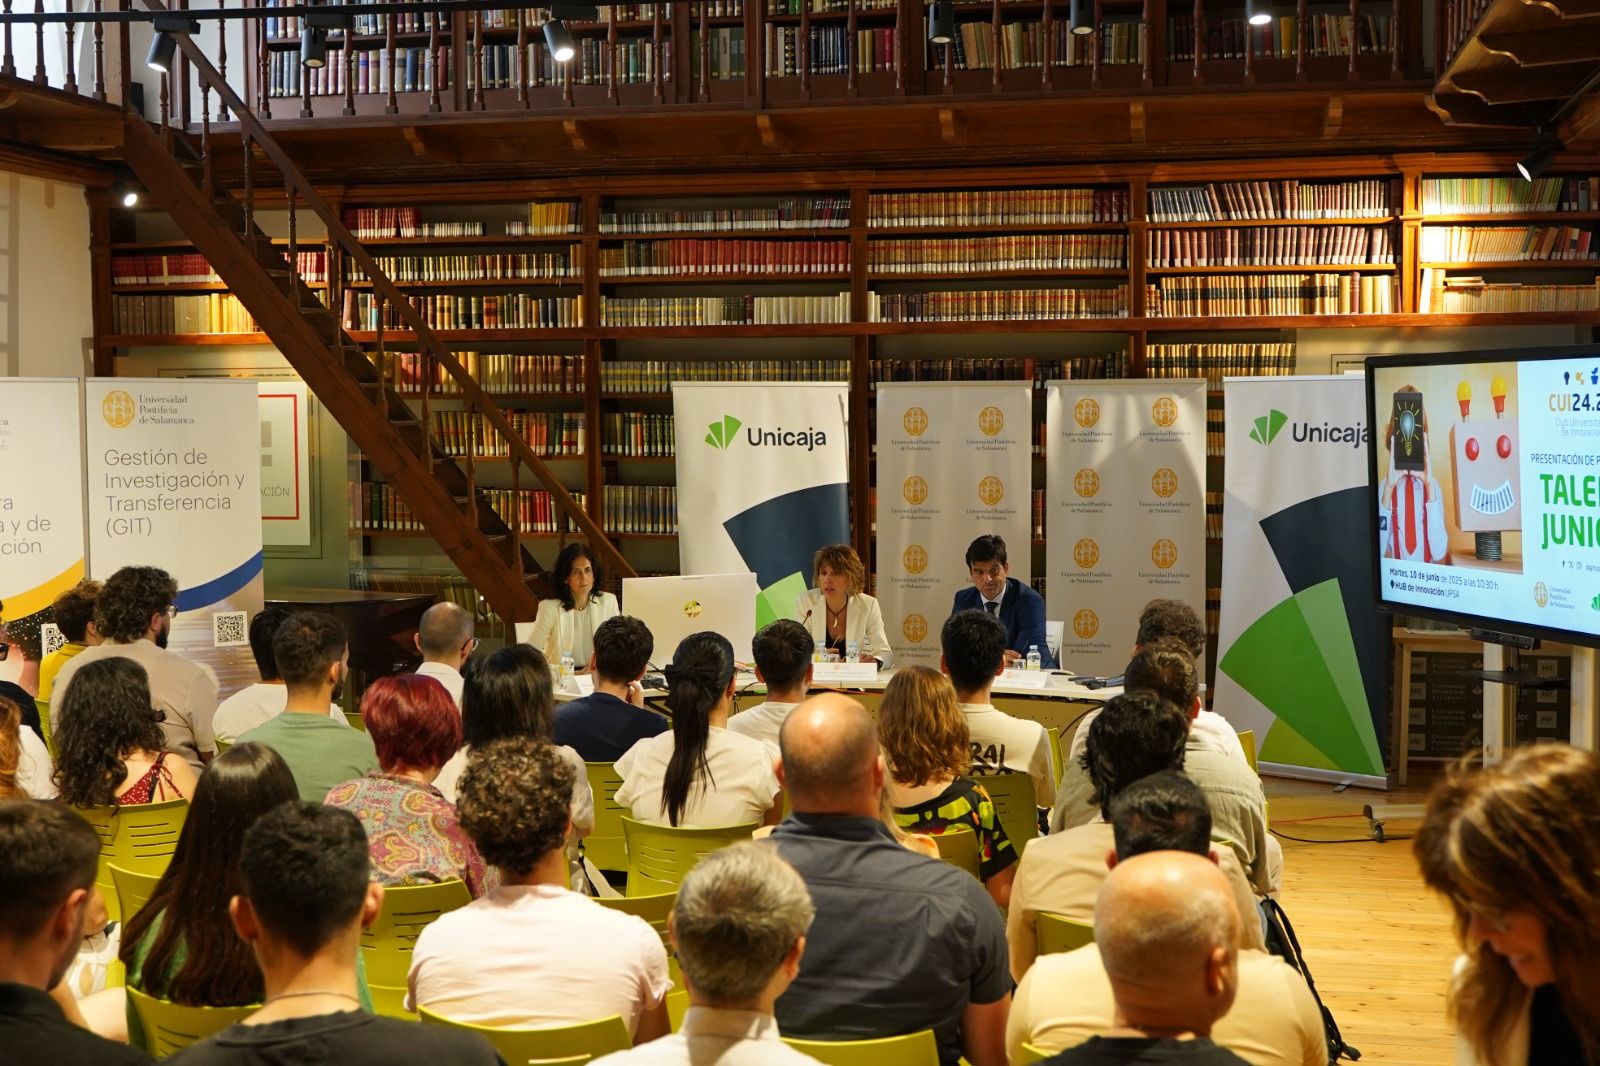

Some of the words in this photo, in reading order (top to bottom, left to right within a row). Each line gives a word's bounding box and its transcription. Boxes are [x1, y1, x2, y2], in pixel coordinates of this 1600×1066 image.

[139, 395, 188, 404] Universidad
[139, 406, 178, 414] Pontificia
[139, 416, 149, 424] de
[150, 416, 195, 424] Salamanca
[747, 427, 826, 451] Unicaja
[1292, 422, 1368, 449] Unicaja
[104, 448, 178, 466] Gestión
[184, 447, 208, 465] de
[1531, 452, 1583, 465] PRESENTACIÓN
[1584, 454, 1595, 466] DE
[105, 470, 230, 492] Investigación
[235, 474, 245, 489] y
[1540, 473, 1600, 508] TALE
[105, 493, 231, 512] Transferencia
[10, 520, 21, 535] y
[26, 515, 51, 532] de
[106, 516, 152, 538] (GIT)
[1389, 567, 1408, 578] Martes,
[1418, 571, 1425, 580] de
[1426, 573, 1440, 582] junio
[1441, 575, 1447, 583] de
[1448, 575, 1462, 585] 2025
[1395, 582, 1406, 591] HUB
[1408, 583, 1415, 591] de
[1415, 584, 1444, 597] Innovación
